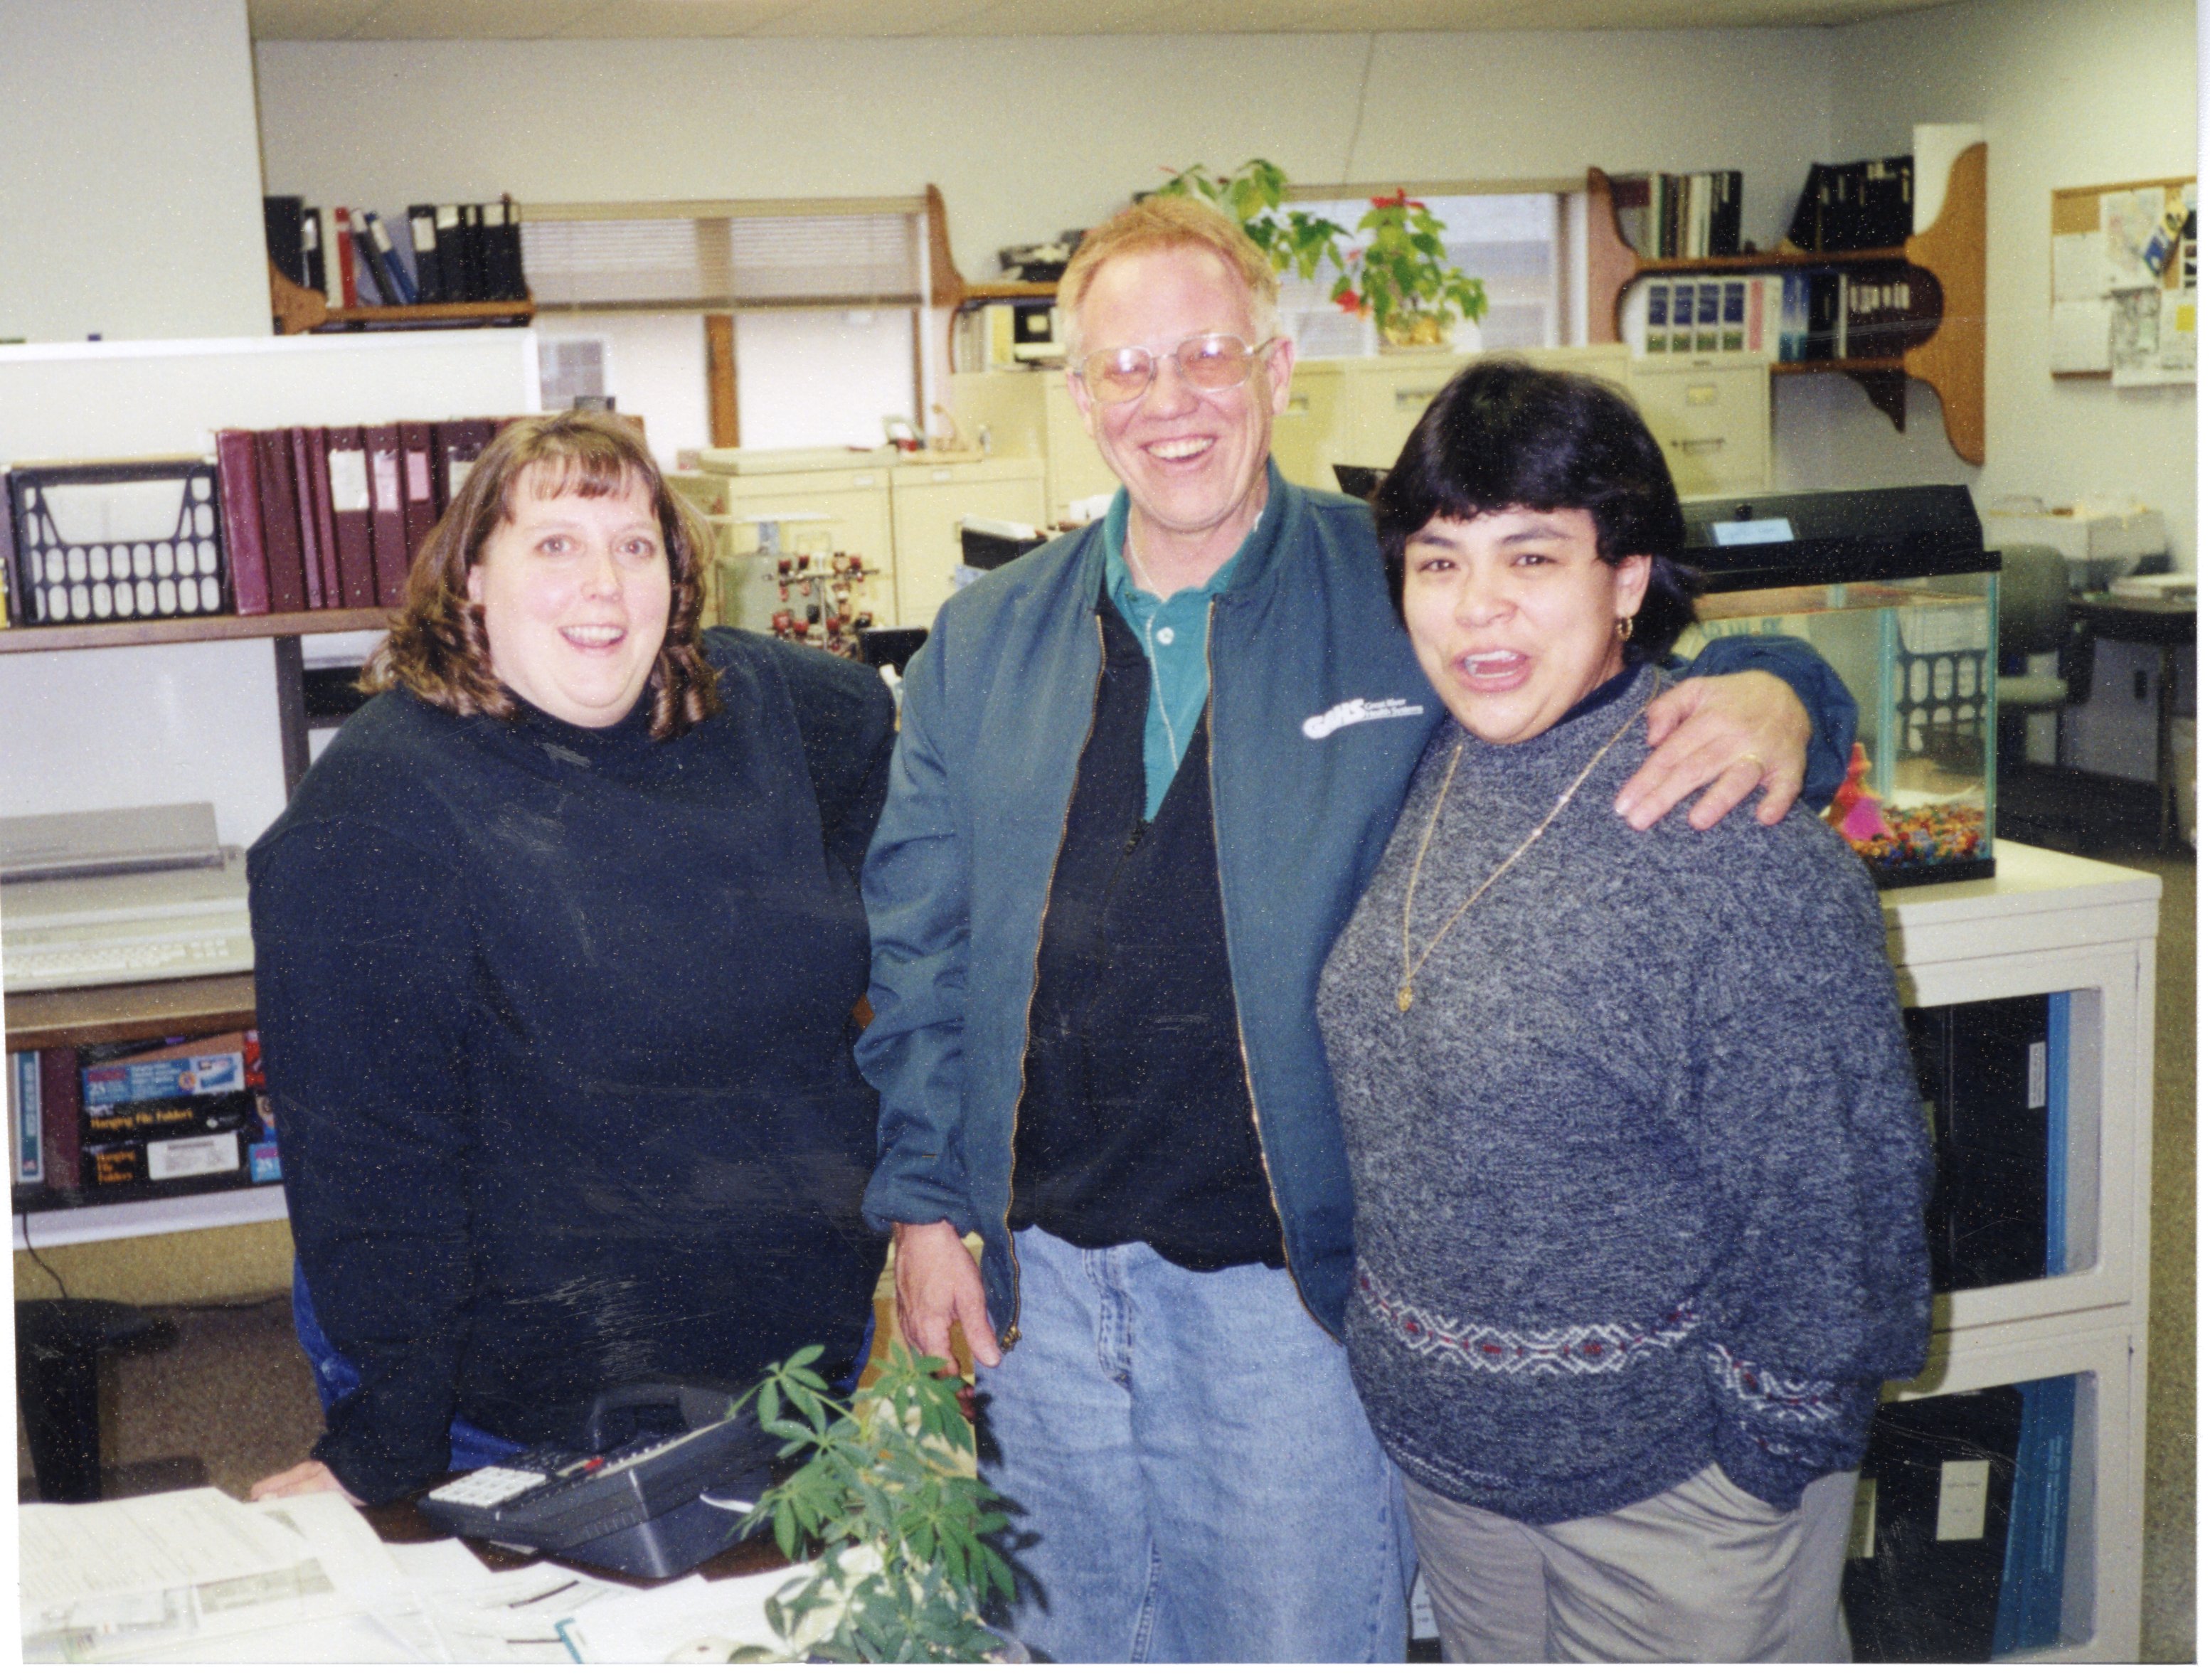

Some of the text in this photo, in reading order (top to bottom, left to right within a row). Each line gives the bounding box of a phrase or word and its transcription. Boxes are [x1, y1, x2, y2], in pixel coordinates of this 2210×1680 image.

[91, 1110, 193, 1130] Hanging File Folders
